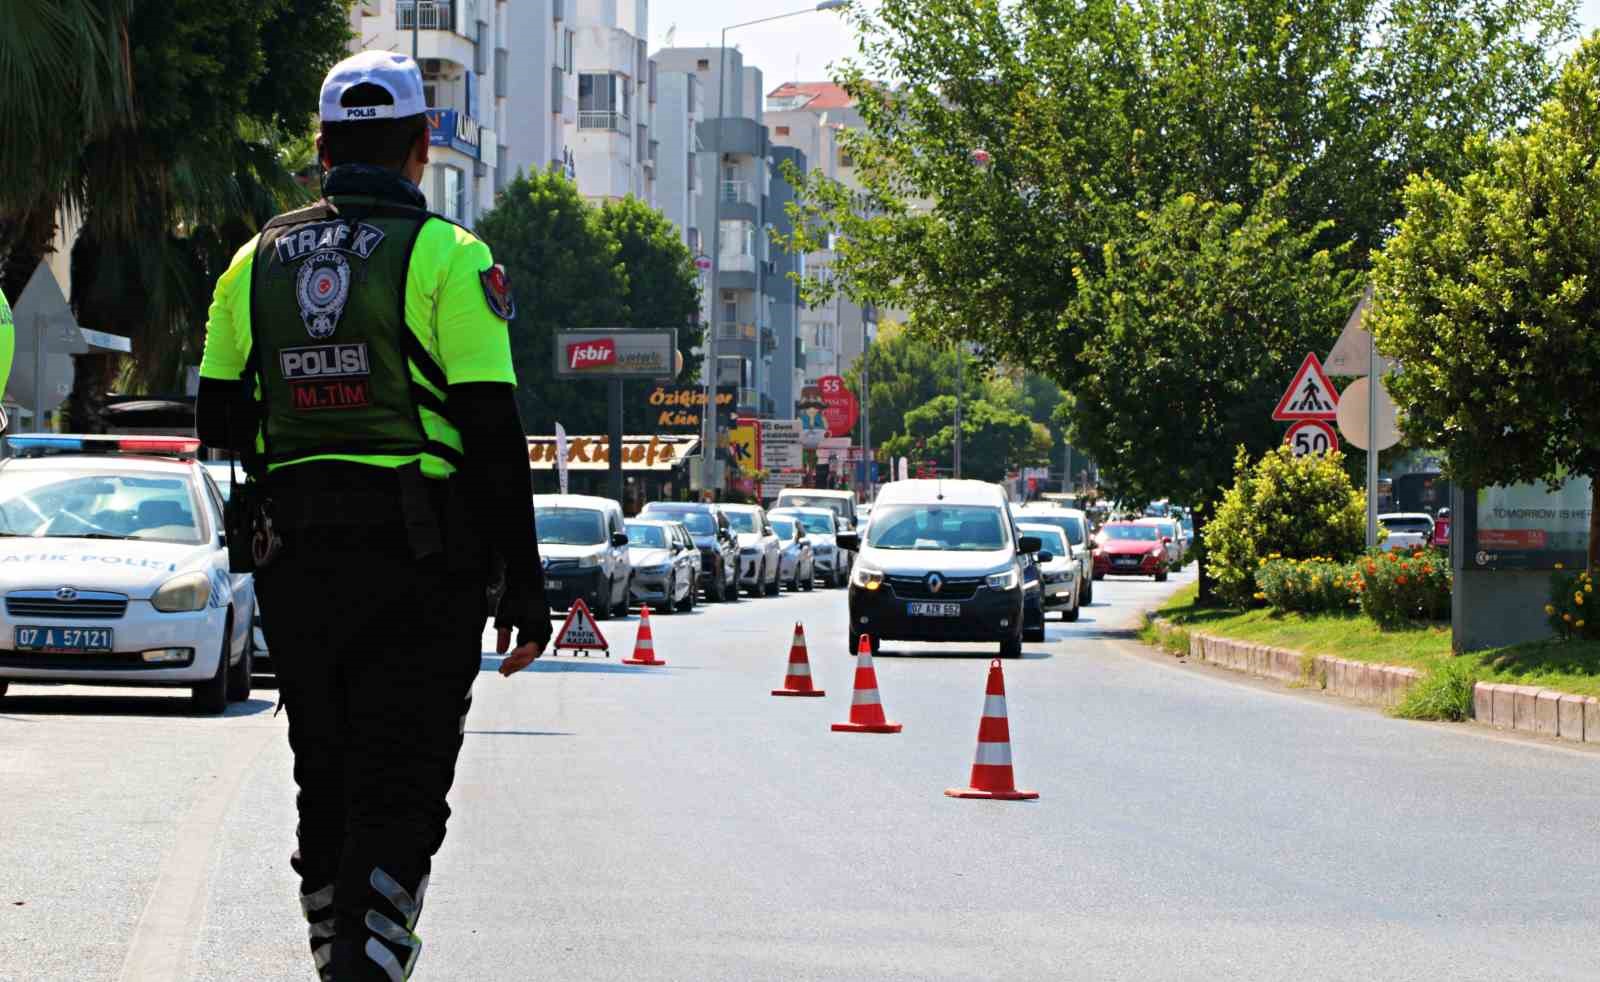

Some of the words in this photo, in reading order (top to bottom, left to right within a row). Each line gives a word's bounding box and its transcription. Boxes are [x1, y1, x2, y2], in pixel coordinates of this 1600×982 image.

[1296, 432, 1328, 458] 50
[1493, 508, 1556, 520] TOMORROW
[1559, 509, 1570, 520] IS
[20, 629, 37, 645] 07
[45, 629, 54, 646] A
[64, 630, 107, 647] 57121
